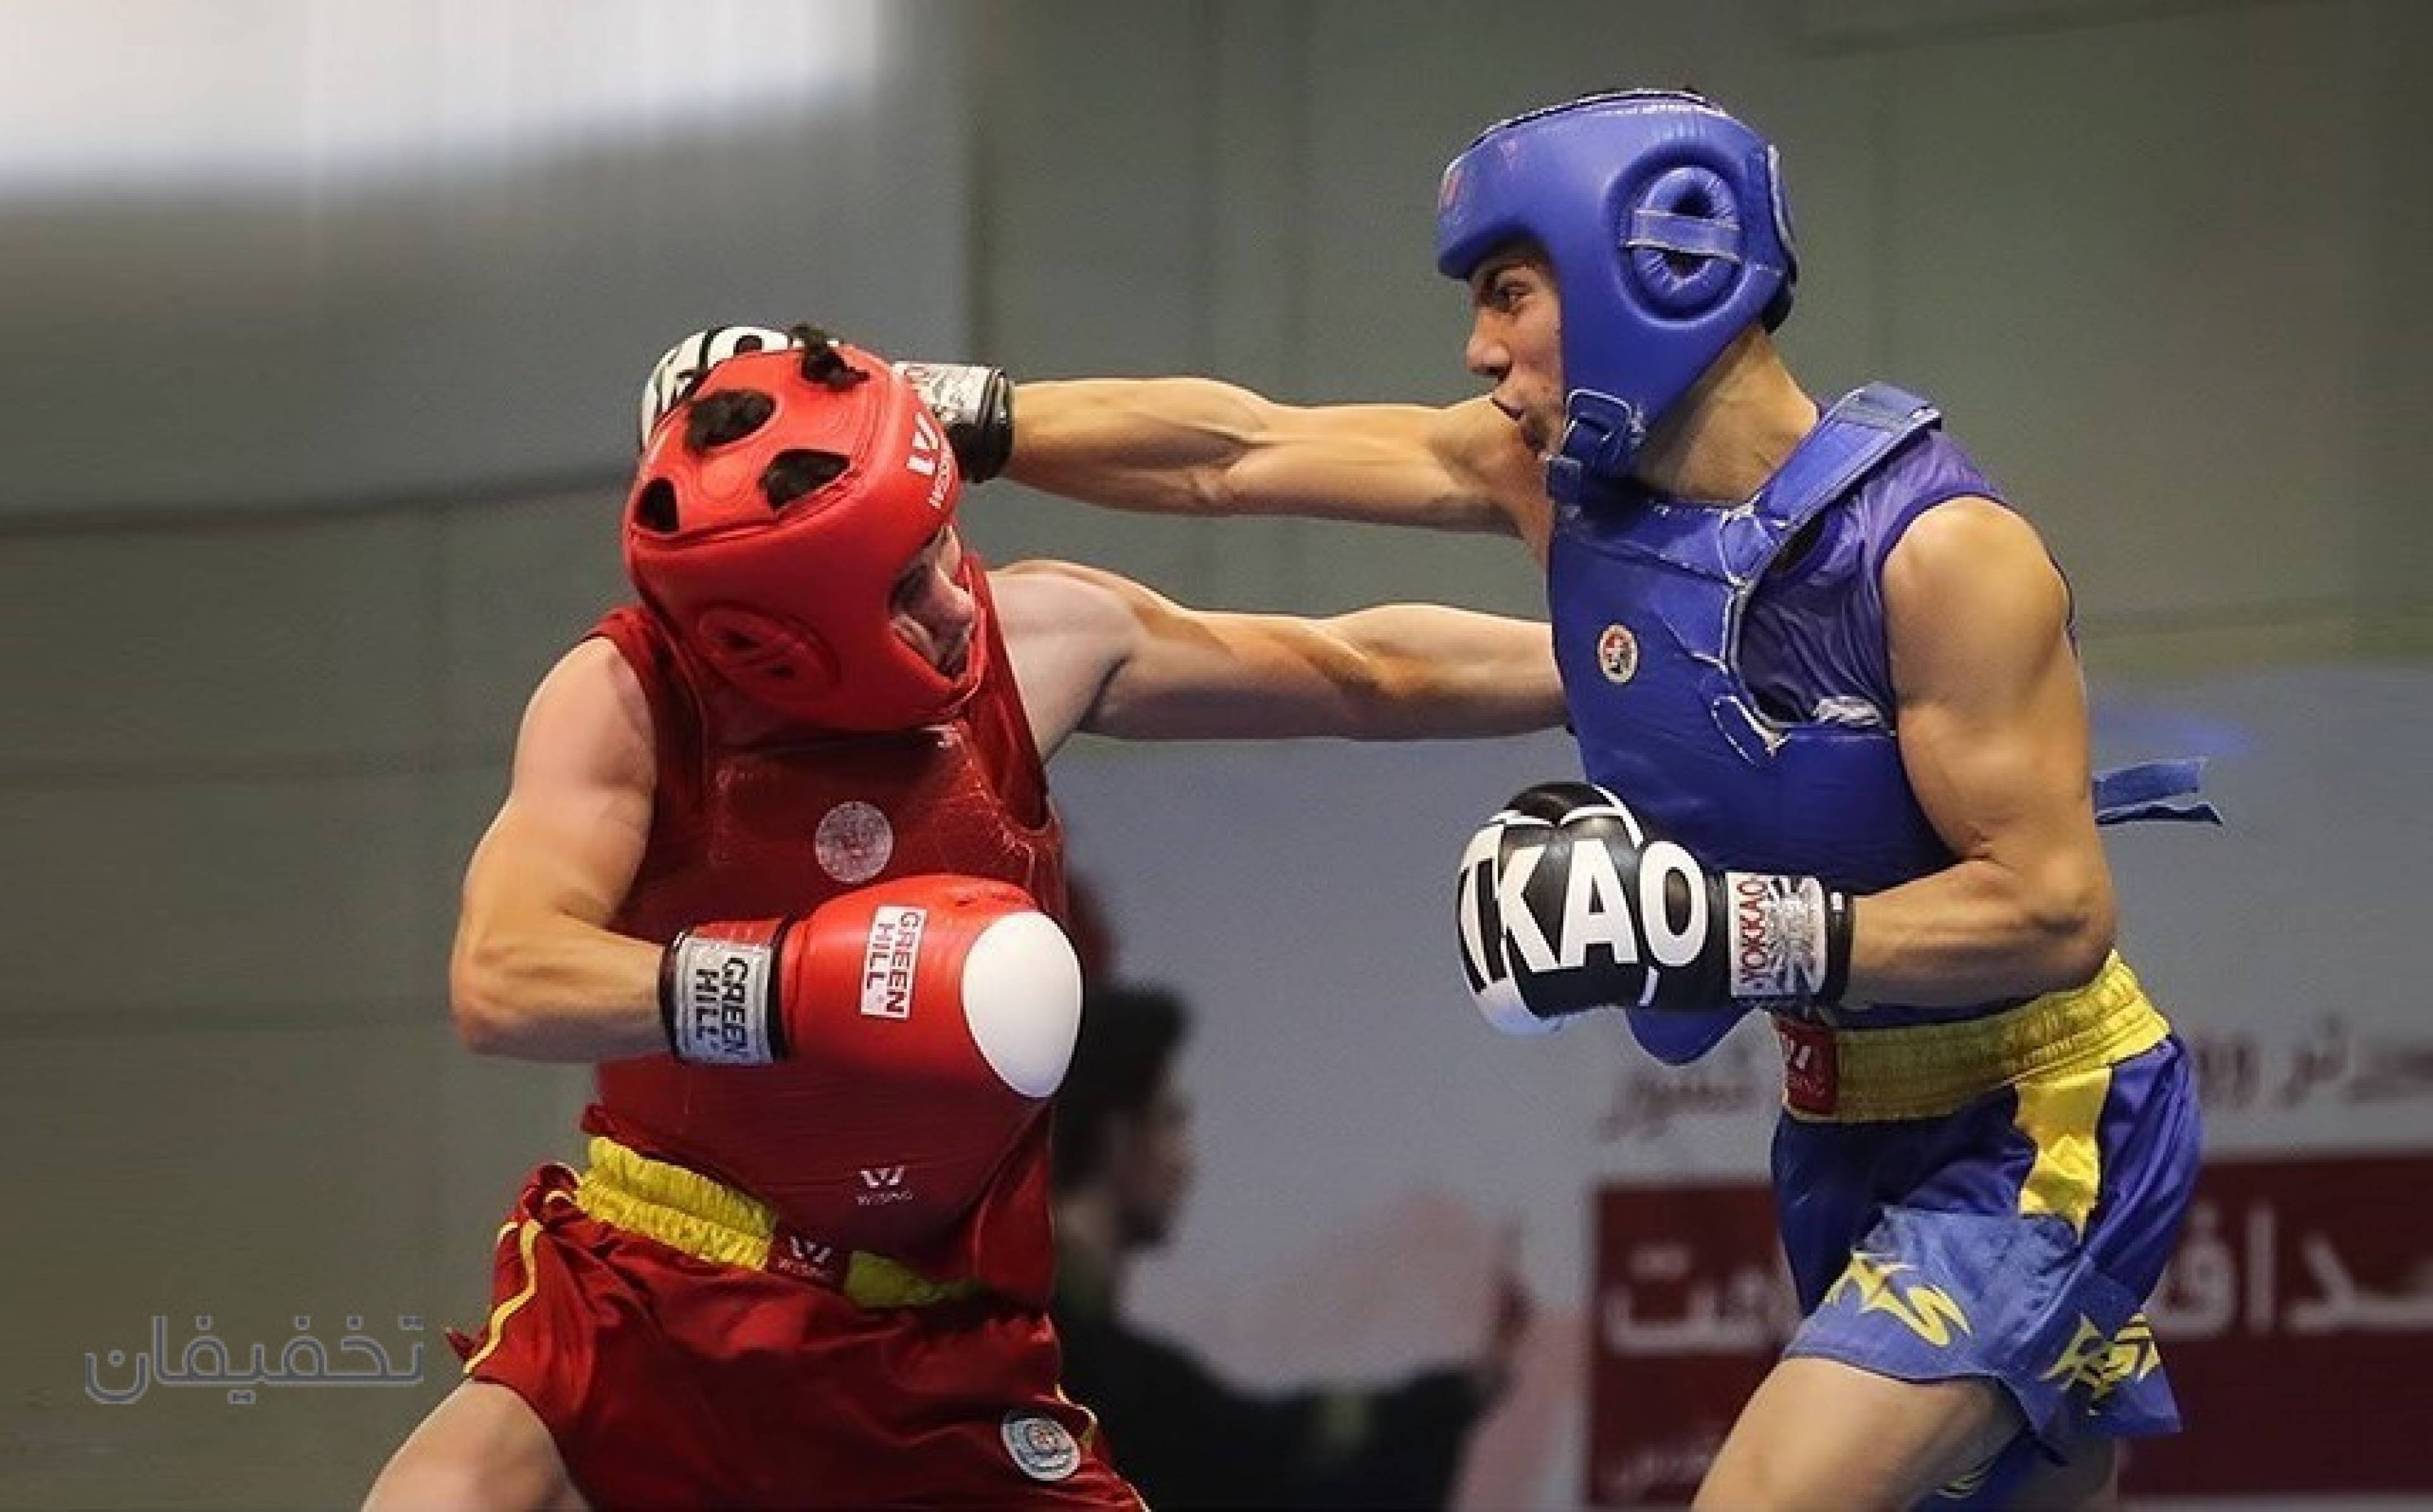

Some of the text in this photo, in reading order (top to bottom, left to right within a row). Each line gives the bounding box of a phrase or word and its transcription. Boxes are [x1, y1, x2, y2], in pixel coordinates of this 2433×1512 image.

[865, 923, 895, 989] HILL
[886, 912, 921, 1013] GREEN
[1737, 880, 1771, 984] YOKKAO
[694, 969, 720, 1041] HILL
[721, 957, 750, 1057] GREEN
